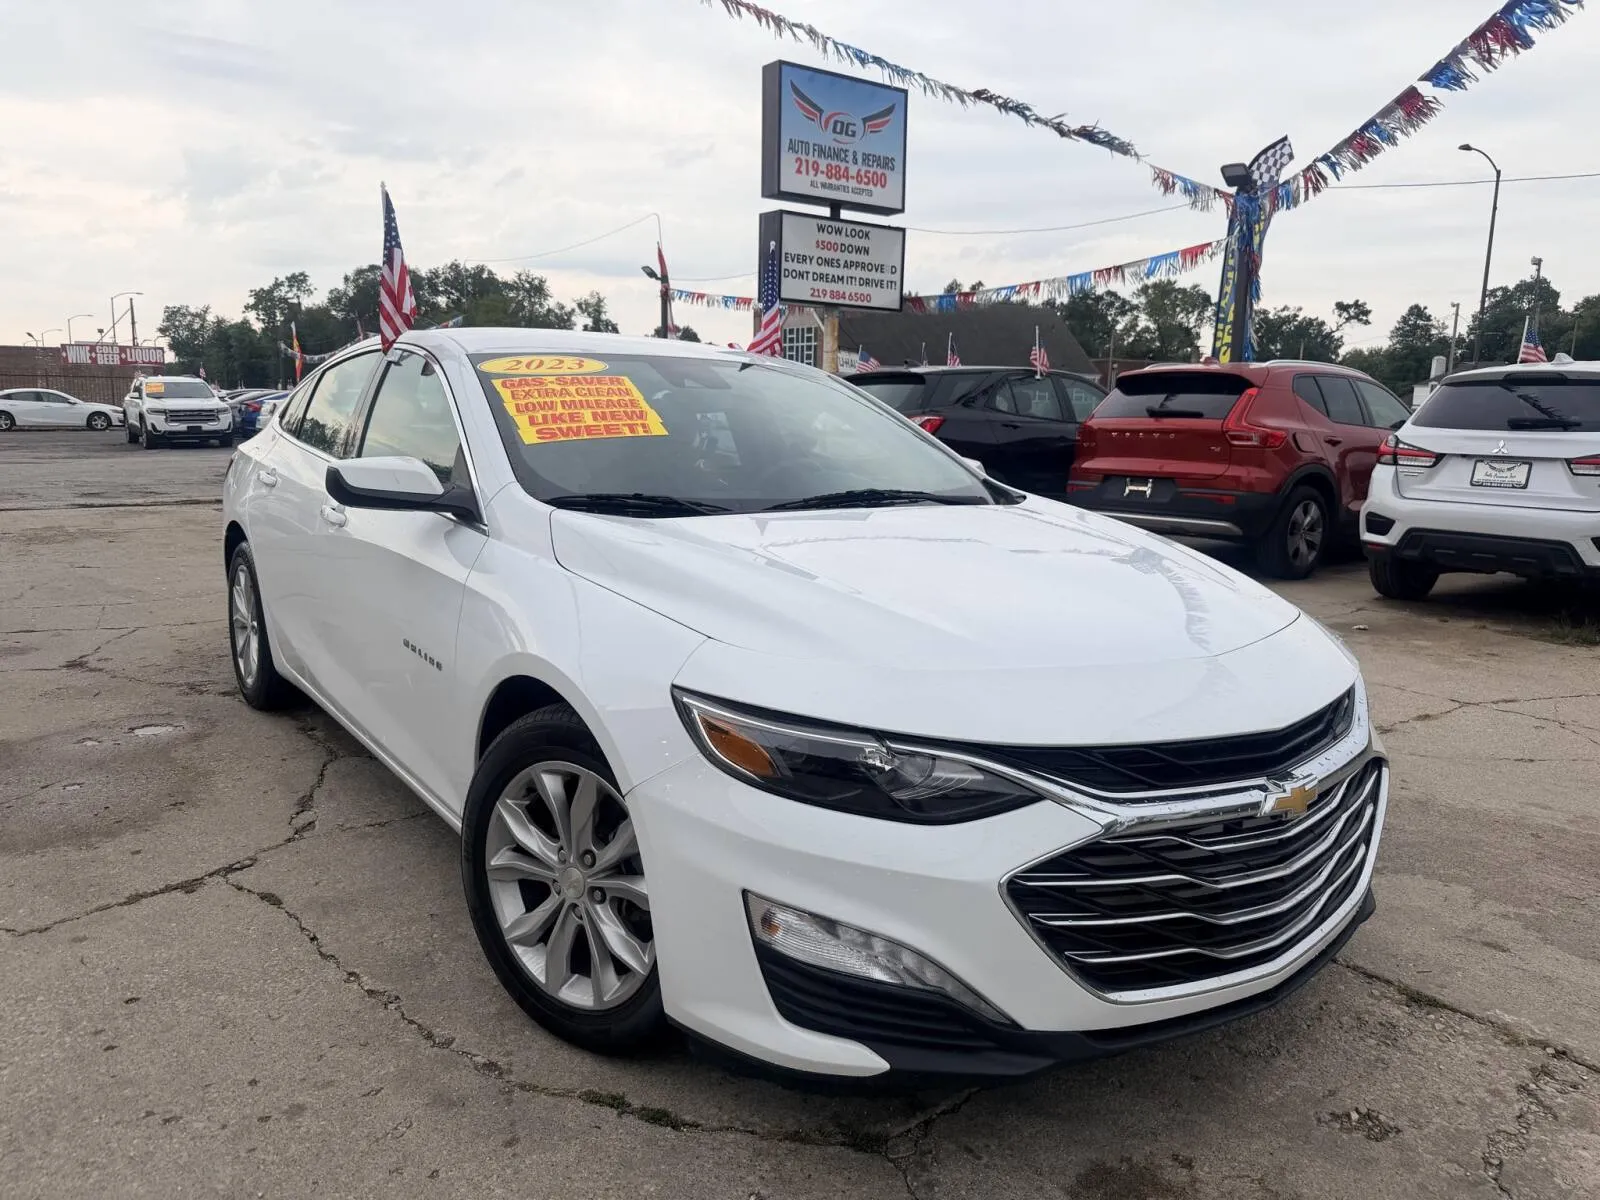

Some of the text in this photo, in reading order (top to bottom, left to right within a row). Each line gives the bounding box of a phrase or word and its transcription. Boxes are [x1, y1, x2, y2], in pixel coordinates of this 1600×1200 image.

[832, 120, 857, 138] OG
[788, 138, 896, 171] AUTO FINANCE & REPAIRS
[795, 157, 888, 188] 219-884-6500
[810, 180, 873, 198] ALL WARRANTIES ACCEPTED
[816, 223, 871, 241] WOW LOOK
[815, 240, 870, 256] $500 DOWN
[784, 252, 815, 265] EVERY
[816, 256, 841, 269] ONES
[783, 268, 897, 291] DONT DREAM IT! DRIVE IT!
[810, 287, 872, 304] 219 884 6500
[66, 345, 91, 364] WINE
[96, 345, 119, 354] COLD
[126, 348, 164, 364] LIQUOR
[97, 353, 120, 365] BEER
[503, 358, 585, 371] 2023
[511, 386, 633, 401] EXTRA CLEAN
[515, 398, 642, 414] LOW MILEAGE
[528, 410, 648, 426] LIKE NEW
[536, 423, 649, 440] SWEET!
